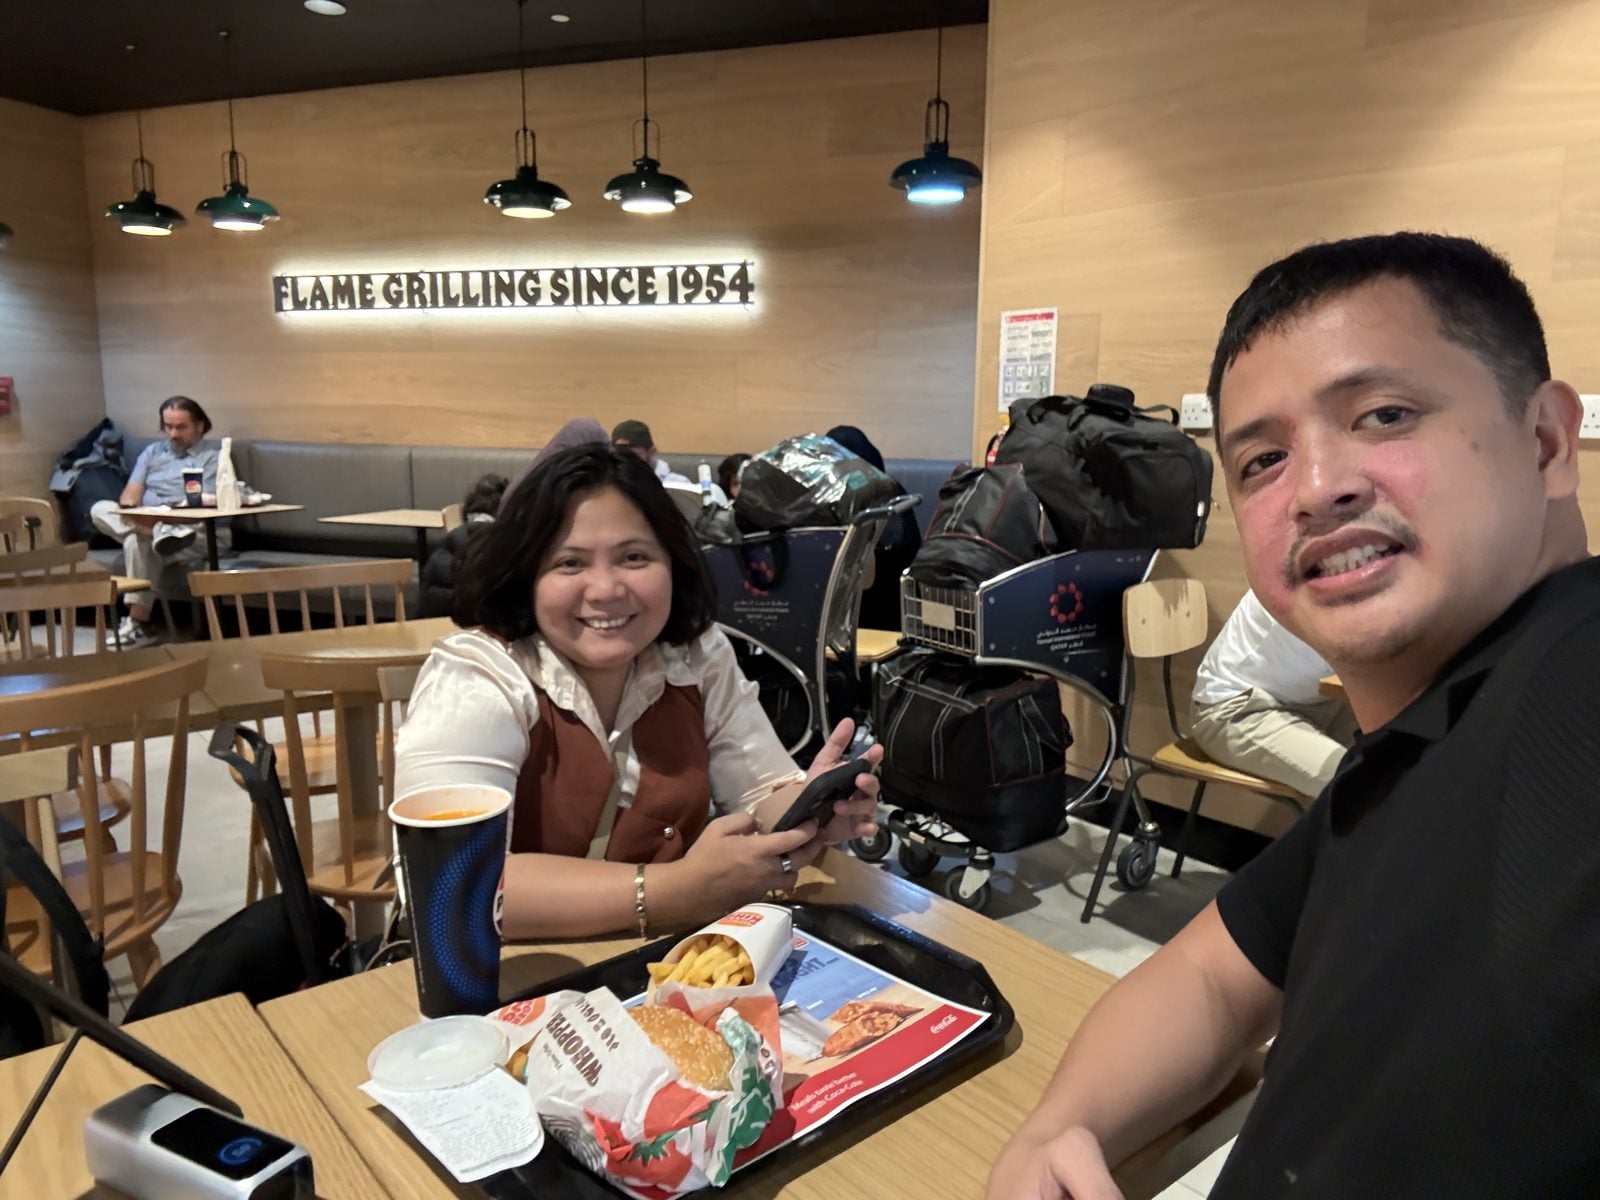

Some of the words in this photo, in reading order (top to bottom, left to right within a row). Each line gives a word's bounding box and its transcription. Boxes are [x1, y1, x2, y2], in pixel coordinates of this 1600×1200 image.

[273, 273, 377, 312] FLAME
[382, 269, 542, 309] GRILLING
[550, 266, 658, 307] SINCE
[667, 262, 755, 305] 1954
[807, 1099, 828, 1114] with
